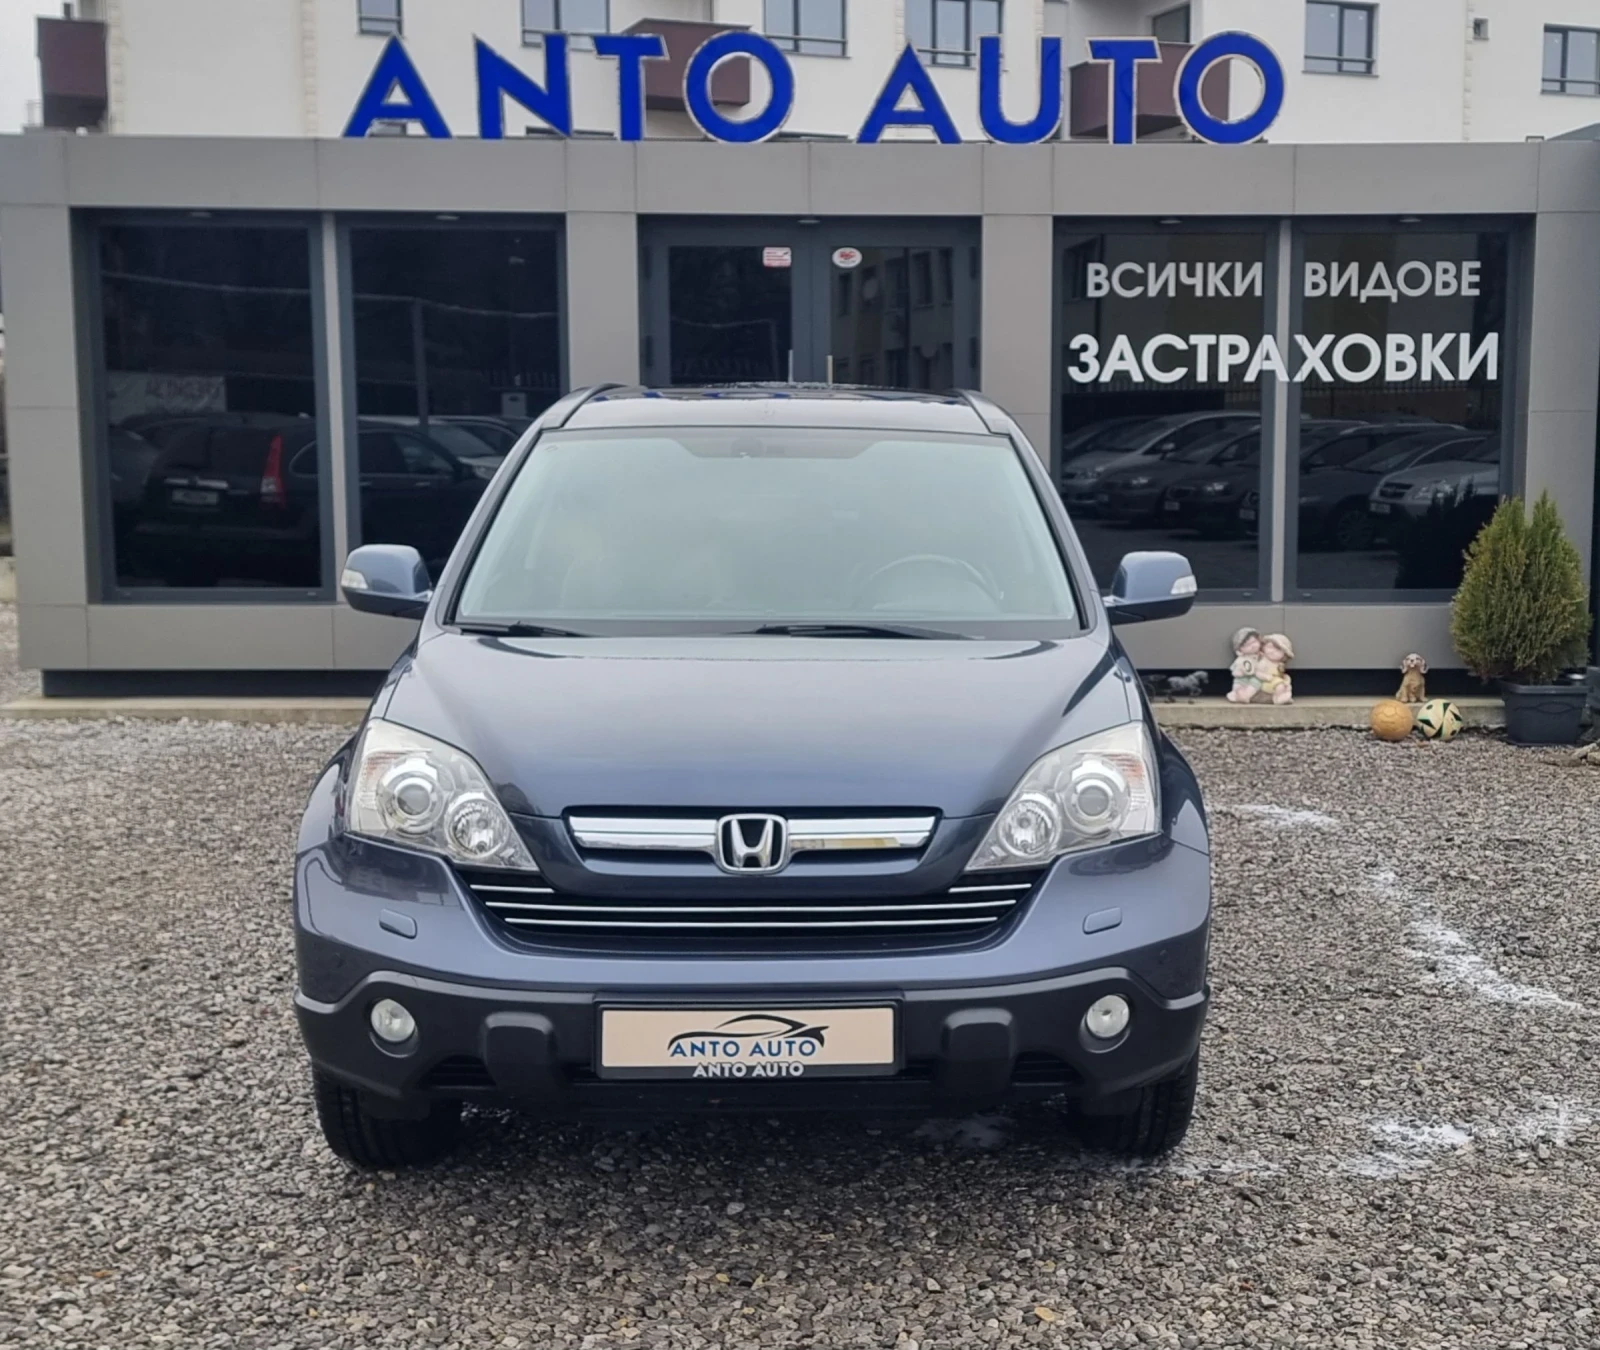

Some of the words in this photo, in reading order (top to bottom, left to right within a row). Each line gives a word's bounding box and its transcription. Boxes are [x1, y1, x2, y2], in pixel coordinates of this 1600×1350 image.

[341, 30, 795, 142] ANTO
[855, 30, 1285, 145] AUTO
[1087, 261, 1263, 298] ВСИЧКИ
[1304, 261, 1481, 303] ВИДОВЕ
[1068, 332, 1499, 384] ЗАСТРАХОВКИ
[670, 1040, 740, 1057] ANTO
[749, 1039, 816, 1057] AUTO
[692, 1061, 747, 1078] ANTO
[751, 1060, 804, 1077] AUTO
